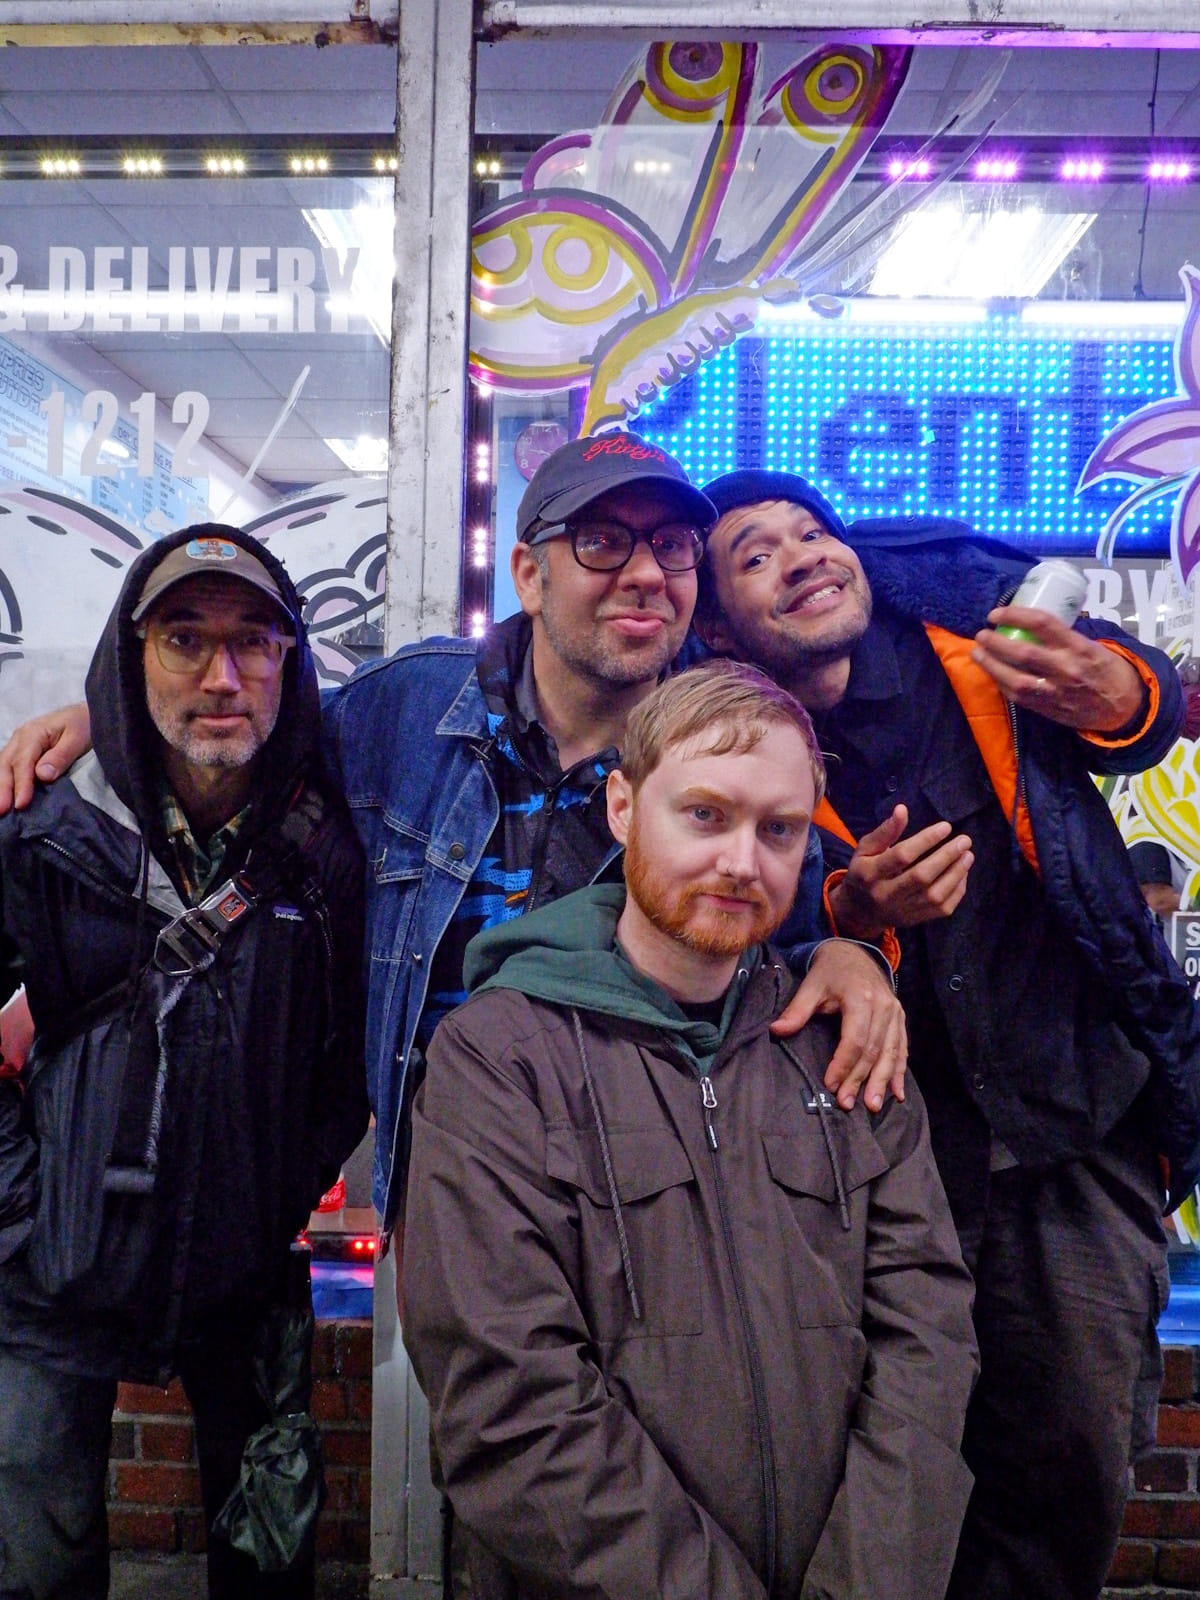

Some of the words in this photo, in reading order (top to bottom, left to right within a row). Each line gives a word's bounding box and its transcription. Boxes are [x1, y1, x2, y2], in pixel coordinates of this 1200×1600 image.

[48, 246, 361, 332] DELIVERY
[1083, 568, 1169, 647] RY
[1185, 921, 1200, 948] S
